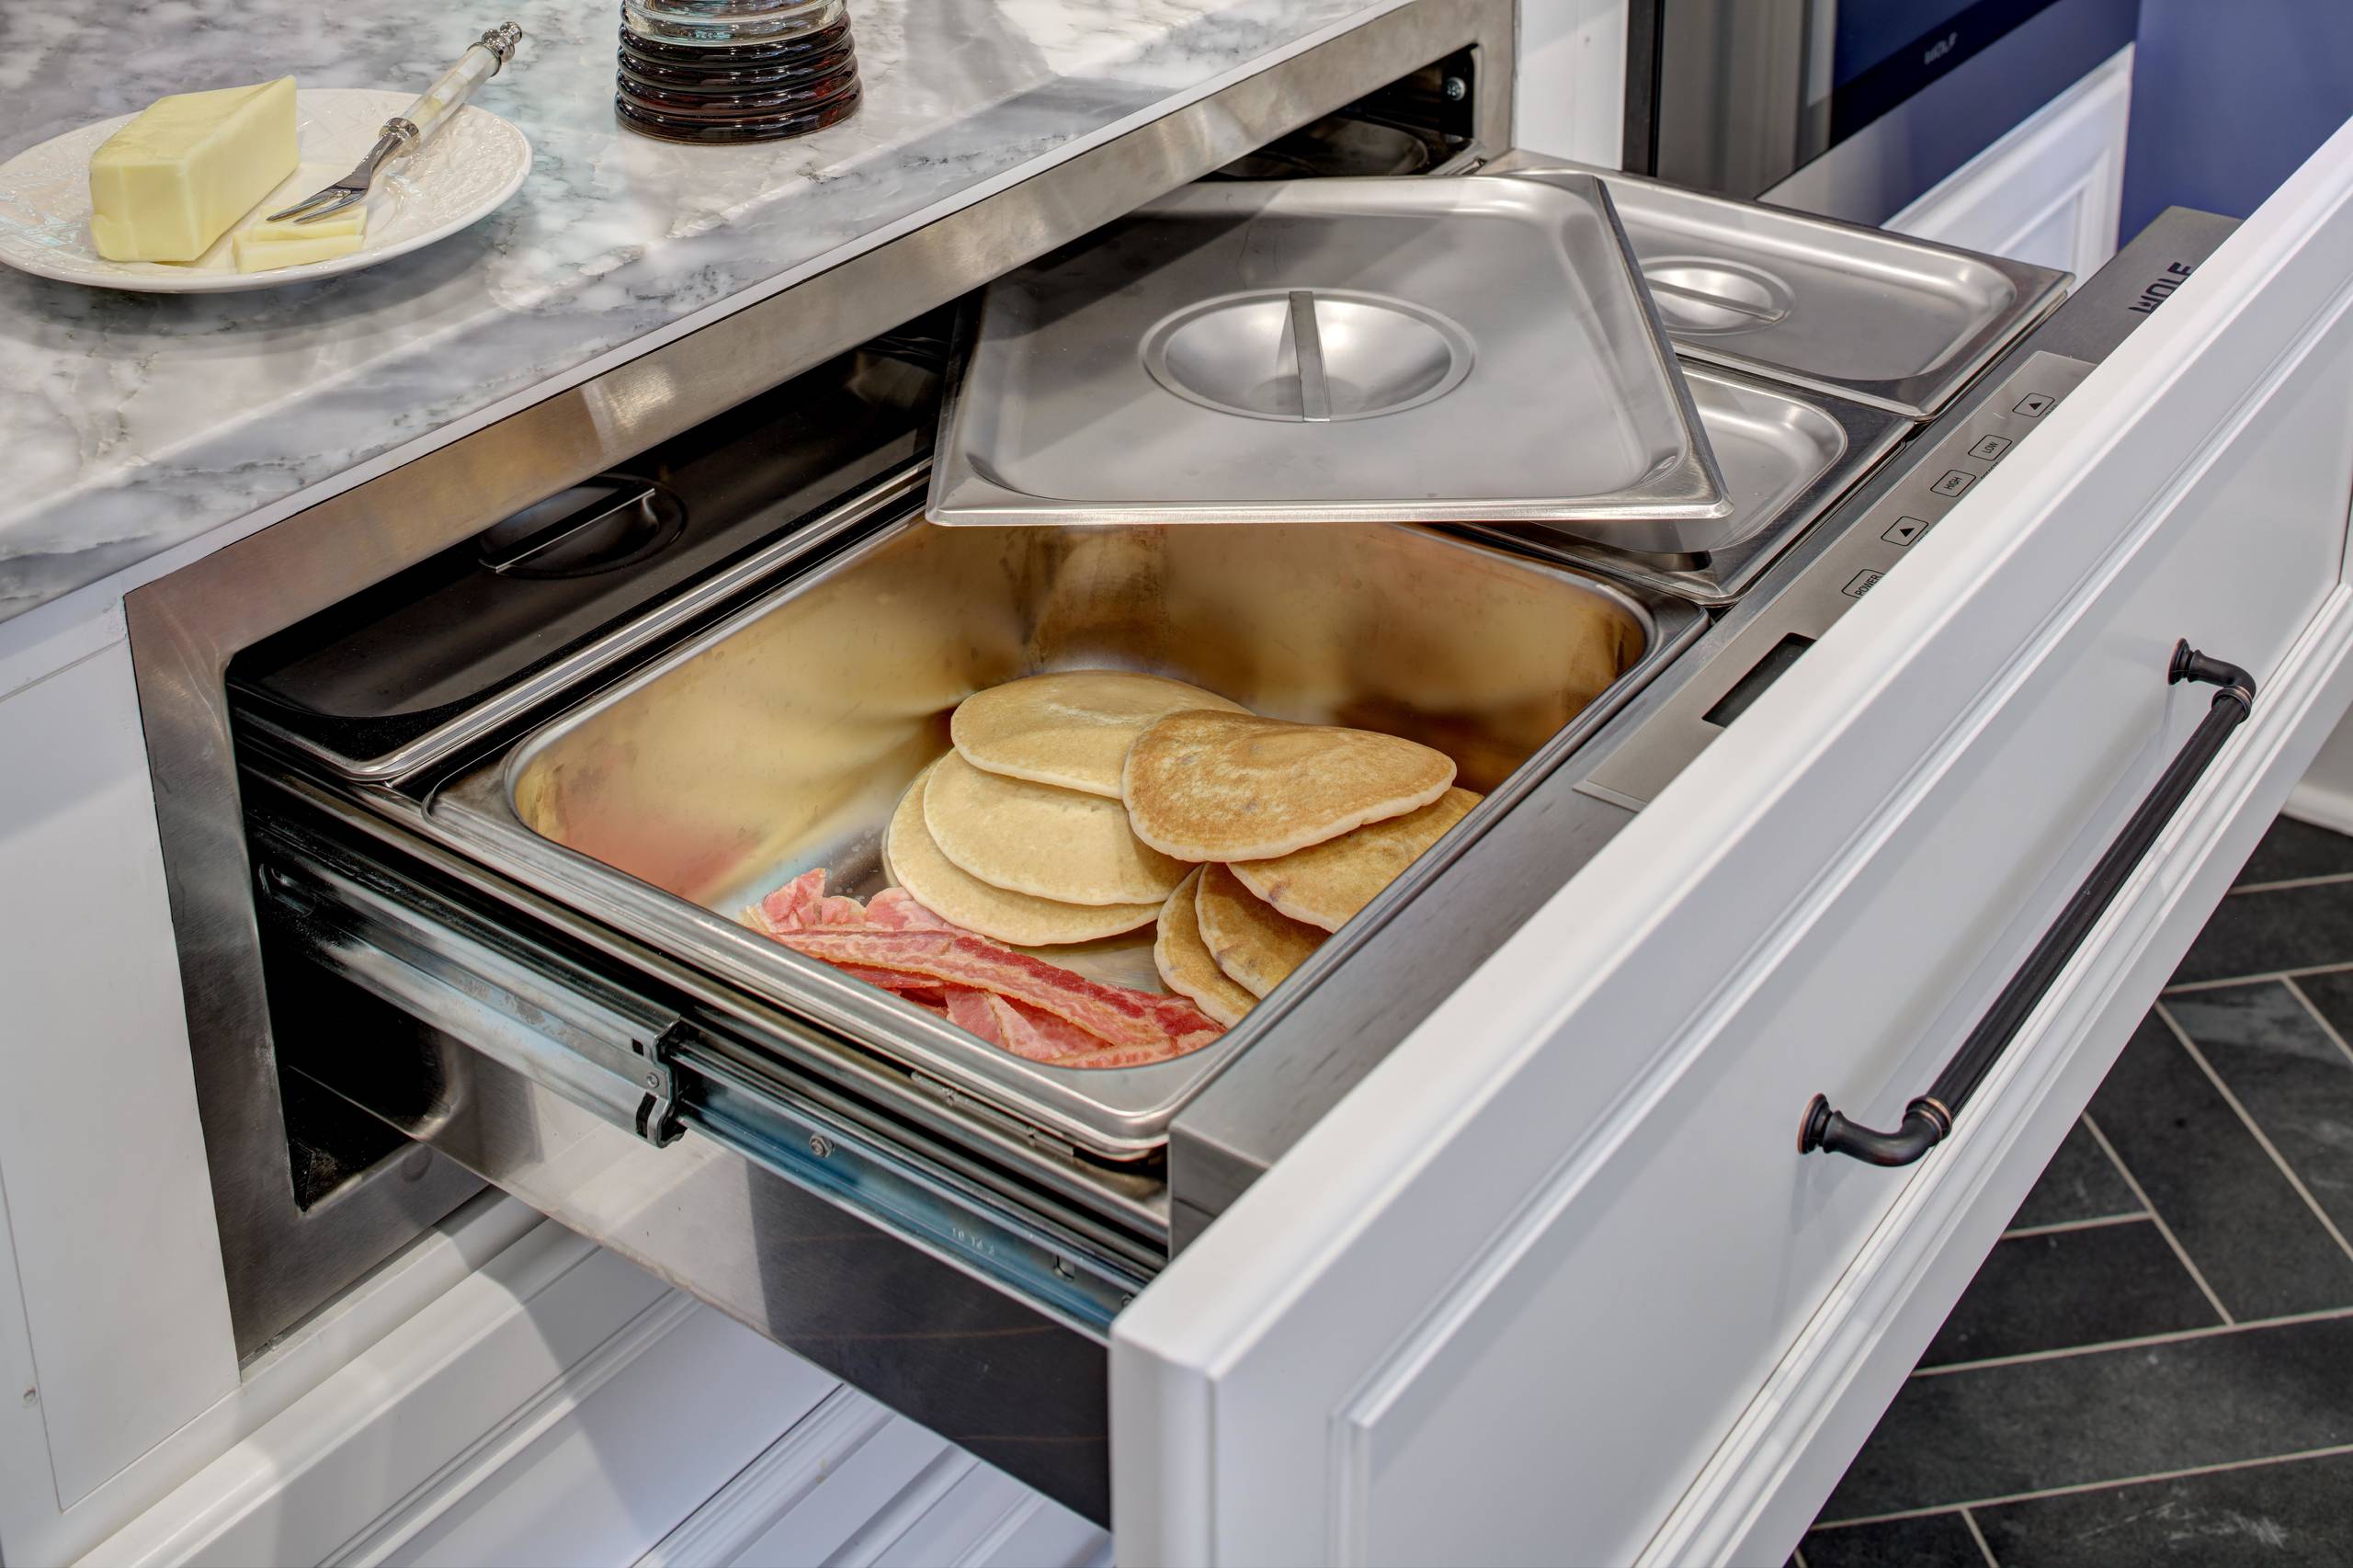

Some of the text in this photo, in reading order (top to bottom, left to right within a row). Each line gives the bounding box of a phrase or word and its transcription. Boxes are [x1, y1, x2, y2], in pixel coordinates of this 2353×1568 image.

[1983, 441, 1998, 454] LOW
[1943, 476, 1962, 490] HIGH
[1854, 574, 1881, 598] POWER
